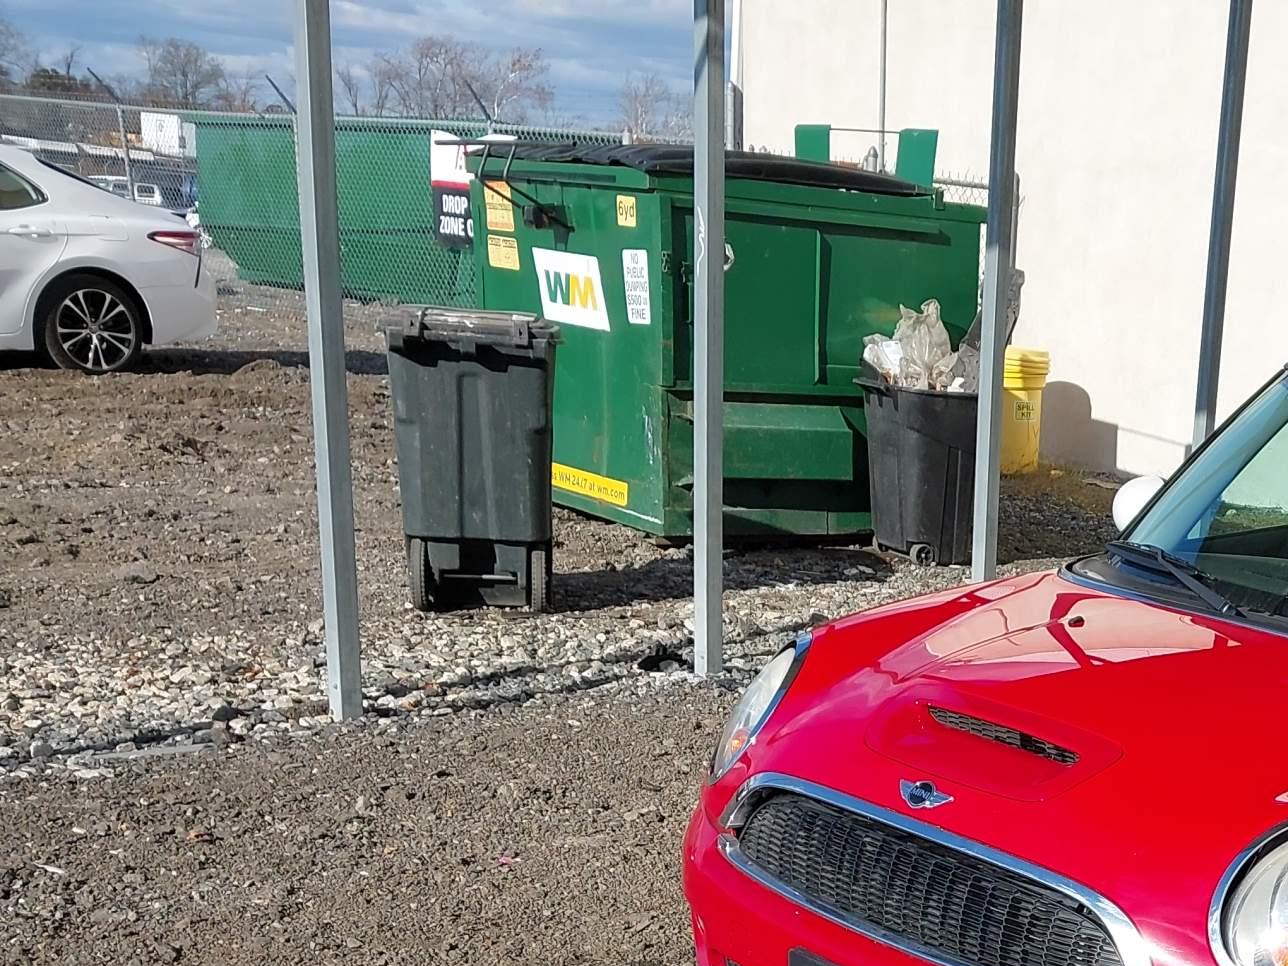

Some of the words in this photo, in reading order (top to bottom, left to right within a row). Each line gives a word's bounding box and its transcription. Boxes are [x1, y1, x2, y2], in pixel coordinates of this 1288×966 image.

[442, 194, 468, 214] DROP
[618, 200, 635, 221] 6yd
[439, 215, 465, 236] ZONE
[543, 269, 598, 311] WM
[631, 308, 647, 320] FINE
[597, 485, 625, 500] wm.com
[911, 787, 930, 800] MINI
